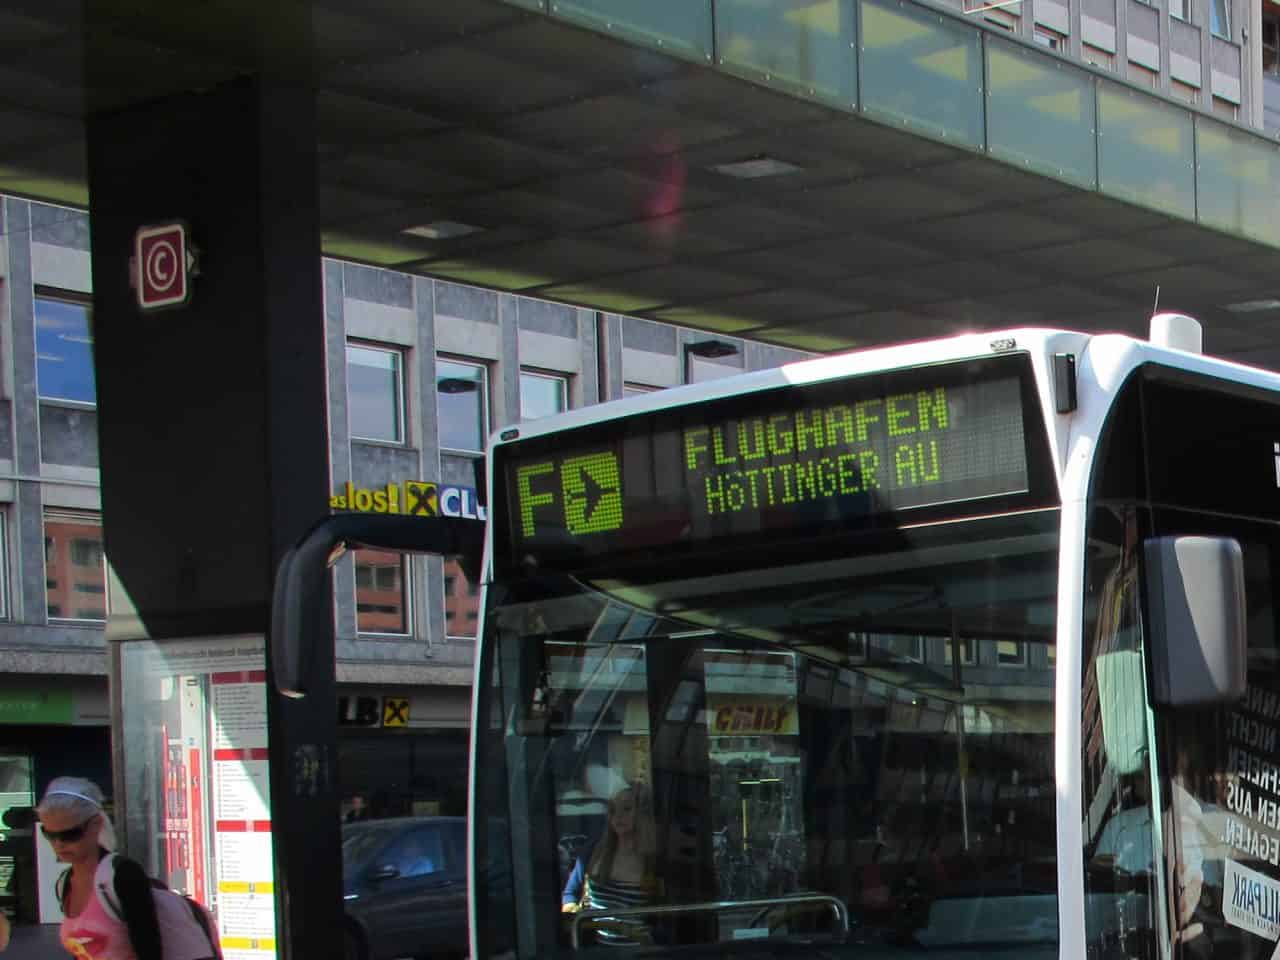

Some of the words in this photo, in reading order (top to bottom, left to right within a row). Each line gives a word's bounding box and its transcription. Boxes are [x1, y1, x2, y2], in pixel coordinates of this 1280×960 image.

[685, 386, 949, 470] FLUGHAFEN
[896, 441, 941, 487] AU
[345, 480, 399, 513] los!
